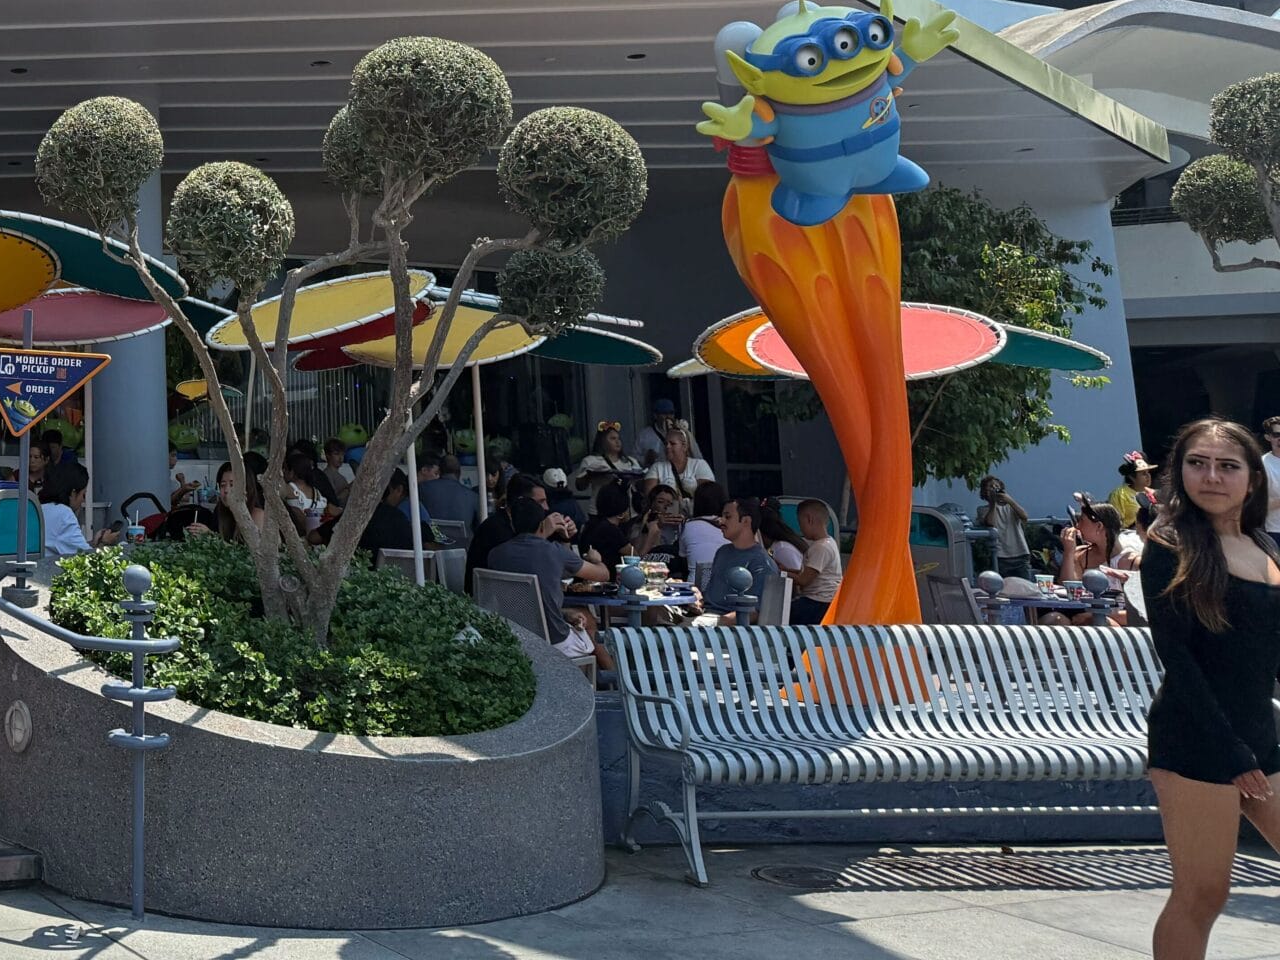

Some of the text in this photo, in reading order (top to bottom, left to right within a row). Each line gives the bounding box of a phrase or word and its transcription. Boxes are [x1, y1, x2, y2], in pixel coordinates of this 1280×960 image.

[15, 355, 82, 368] MOBILE ORDER
[21, 364, 56, 375] PICKUP
[25, 384, 55, 395] ORDER
